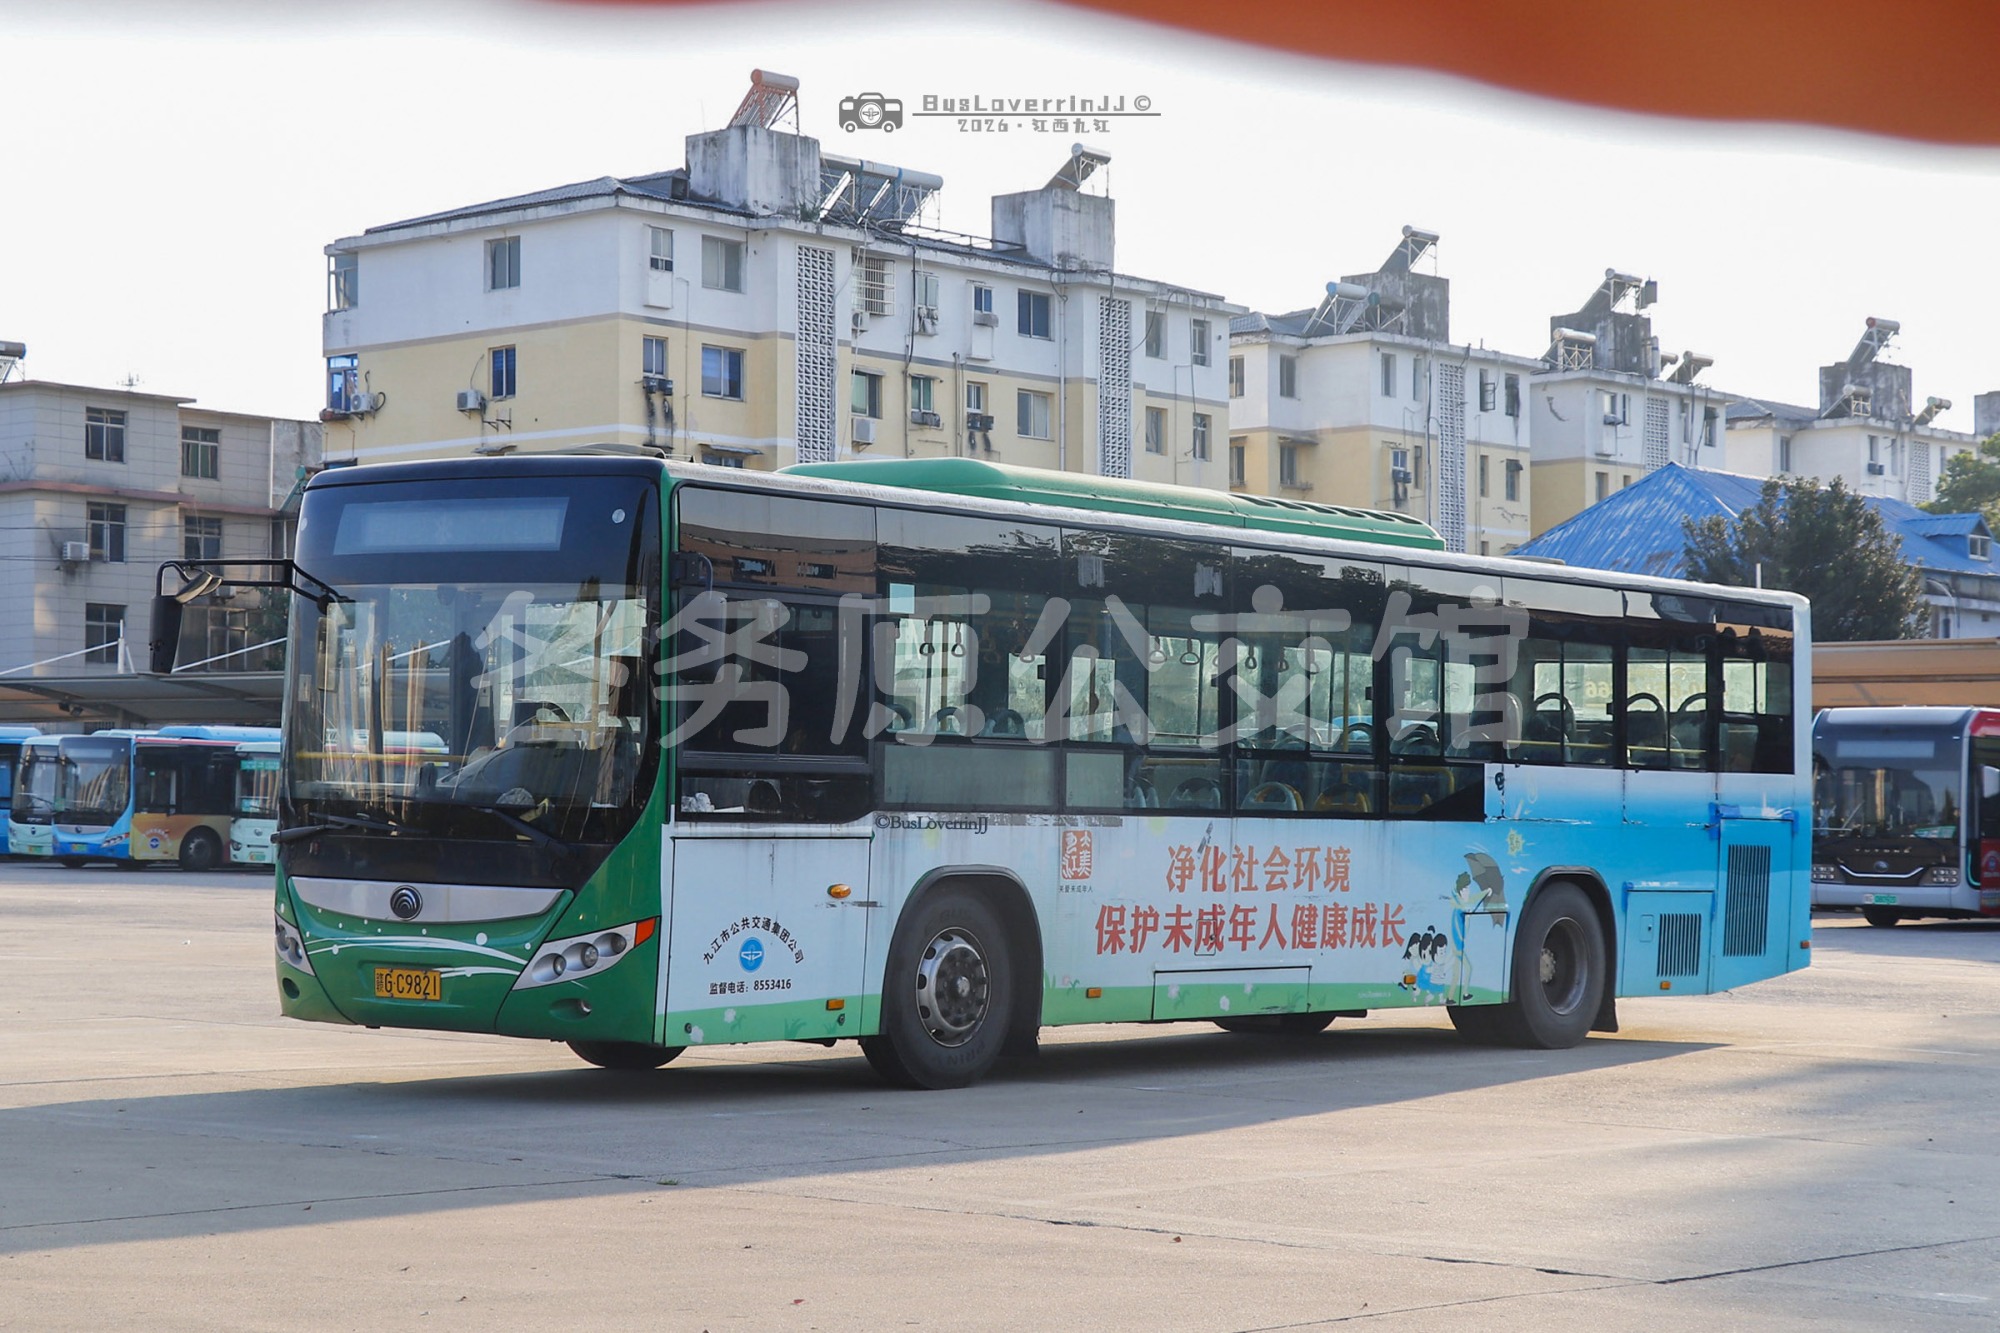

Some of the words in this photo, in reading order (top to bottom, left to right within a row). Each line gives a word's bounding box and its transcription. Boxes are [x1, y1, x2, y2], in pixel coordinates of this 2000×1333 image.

[1167, 845, 1351, 894] 净化社会环境
[703, 916, 804, 965] 九江市公共交通集团公司
[1095, 902, 1407, 956] 保护未成年人健康成长
